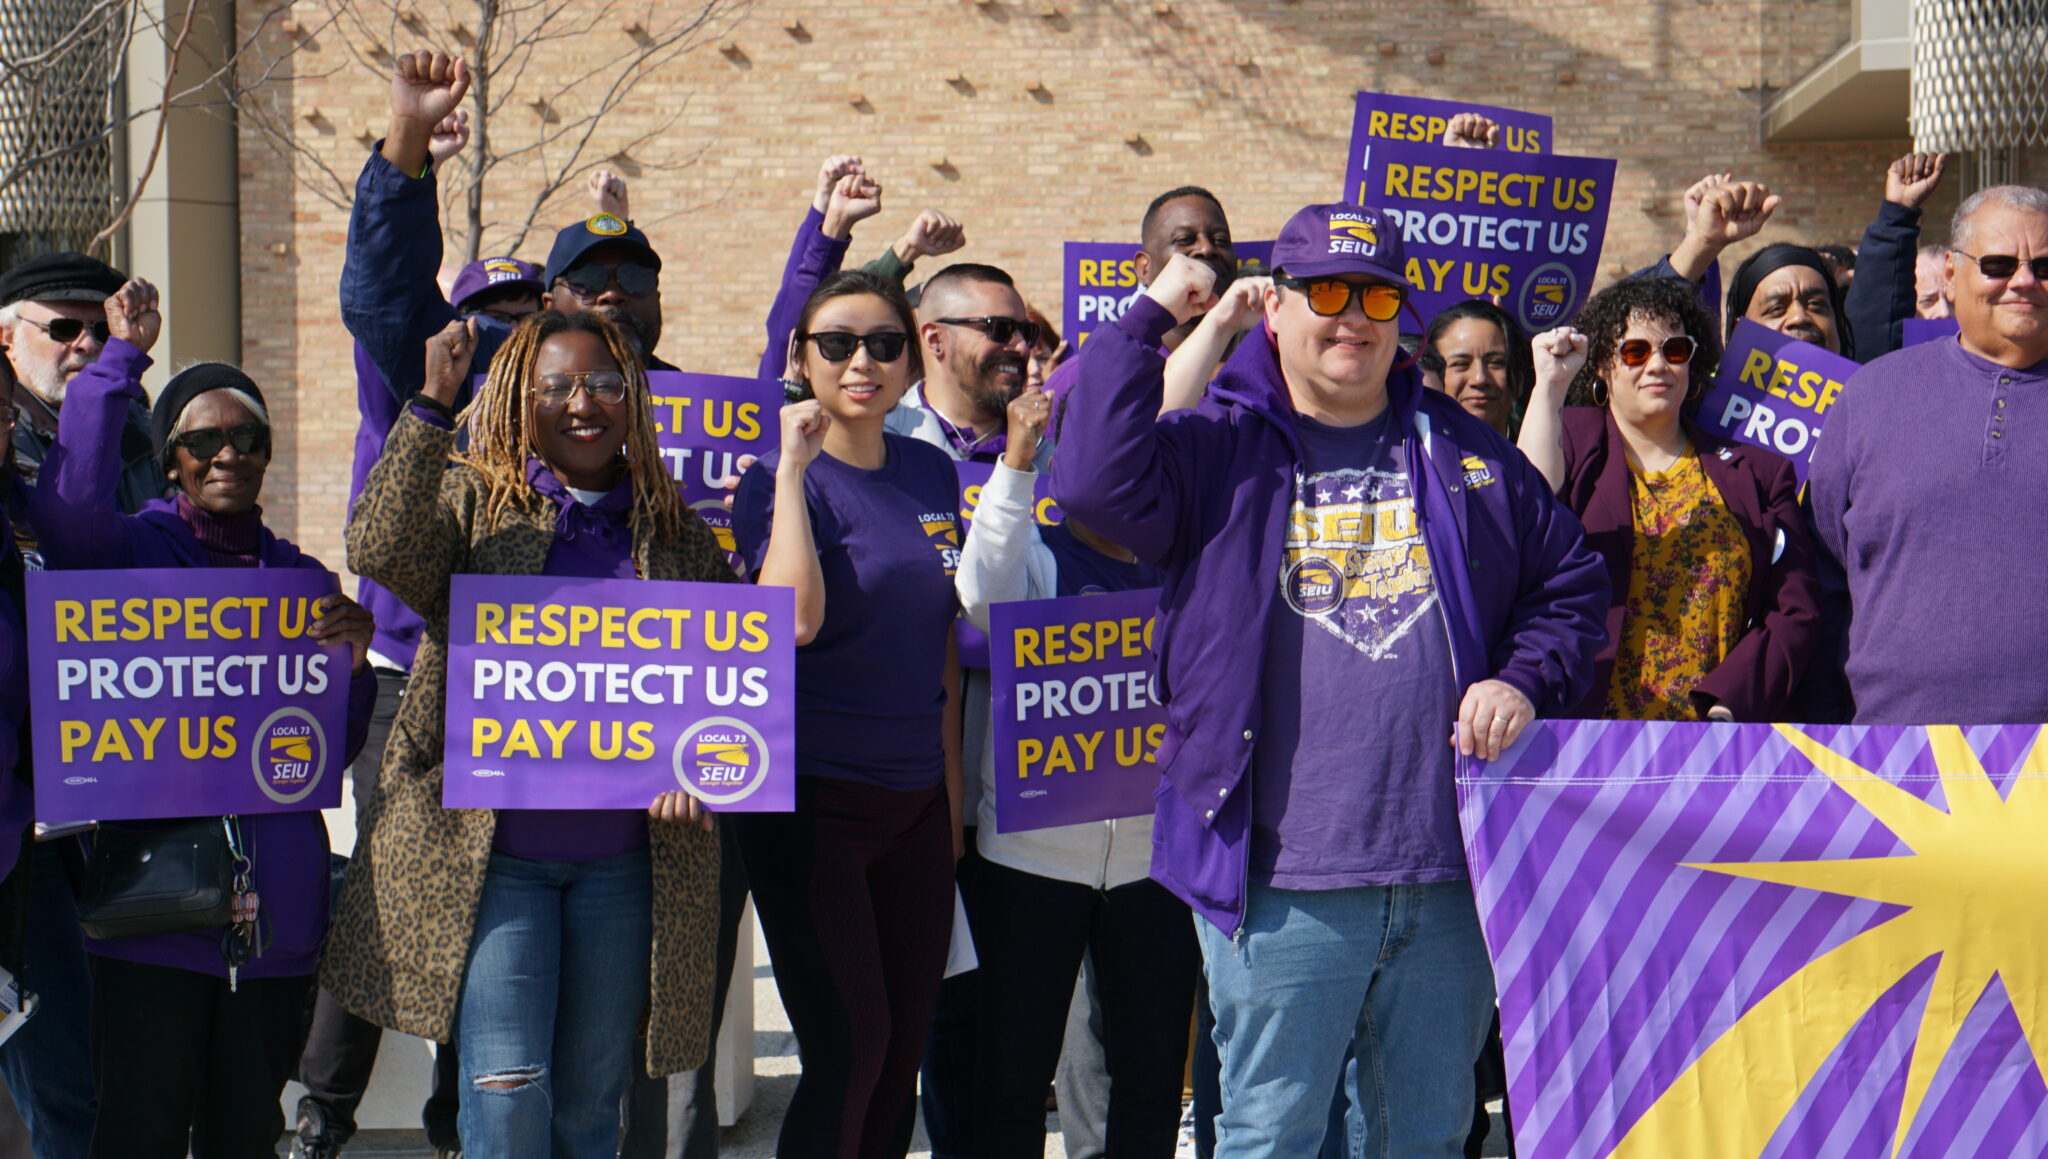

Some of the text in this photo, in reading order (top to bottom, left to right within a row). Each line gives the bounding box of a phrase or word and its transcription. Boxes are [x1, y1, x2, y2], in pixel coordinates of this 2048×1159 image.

[1506, 125, 1541, 154] US
[1384, 163, 1545, 208] RESPECT
[1551, 177, 1597, 212] US
[1330, 213, 1377, 225] LOCAL 73
[1328, 240, 1377, 257] SEIU
[1548, 222, 1590, 255] US
[1462, 262, 1511, 297] US
[1531, 304, 1560, 316] SEIU
[703, 399, 761, 440] US
[1463, 468, 1491, 486] SEIU
[918, 513, 946, 522] LOCAL
[1285, 508, 1422, 544] SEIU
[1344, 544, 1409, 579] Stronger
[1299, 584, 1333, 598] SEIU
[55, 597, 268, 642] RESPECT
[475, 603, 769, 652] RESPECT US
[57, 654, 328, 700] PROTECT US
[473, 659, 769, 707] PROTECT US
[60, 716, 237, 763] PAY US
[272, 726, 310, 736] LOCAL 73
[471, 718, 655, 760] PAY US
[699, 734, 747, 743] LOCAL 73
[273, 762, 309, 779] SEIU
[1018, 731, 1104, 778] PAY
[700, 767, 746, 782] SEIU
